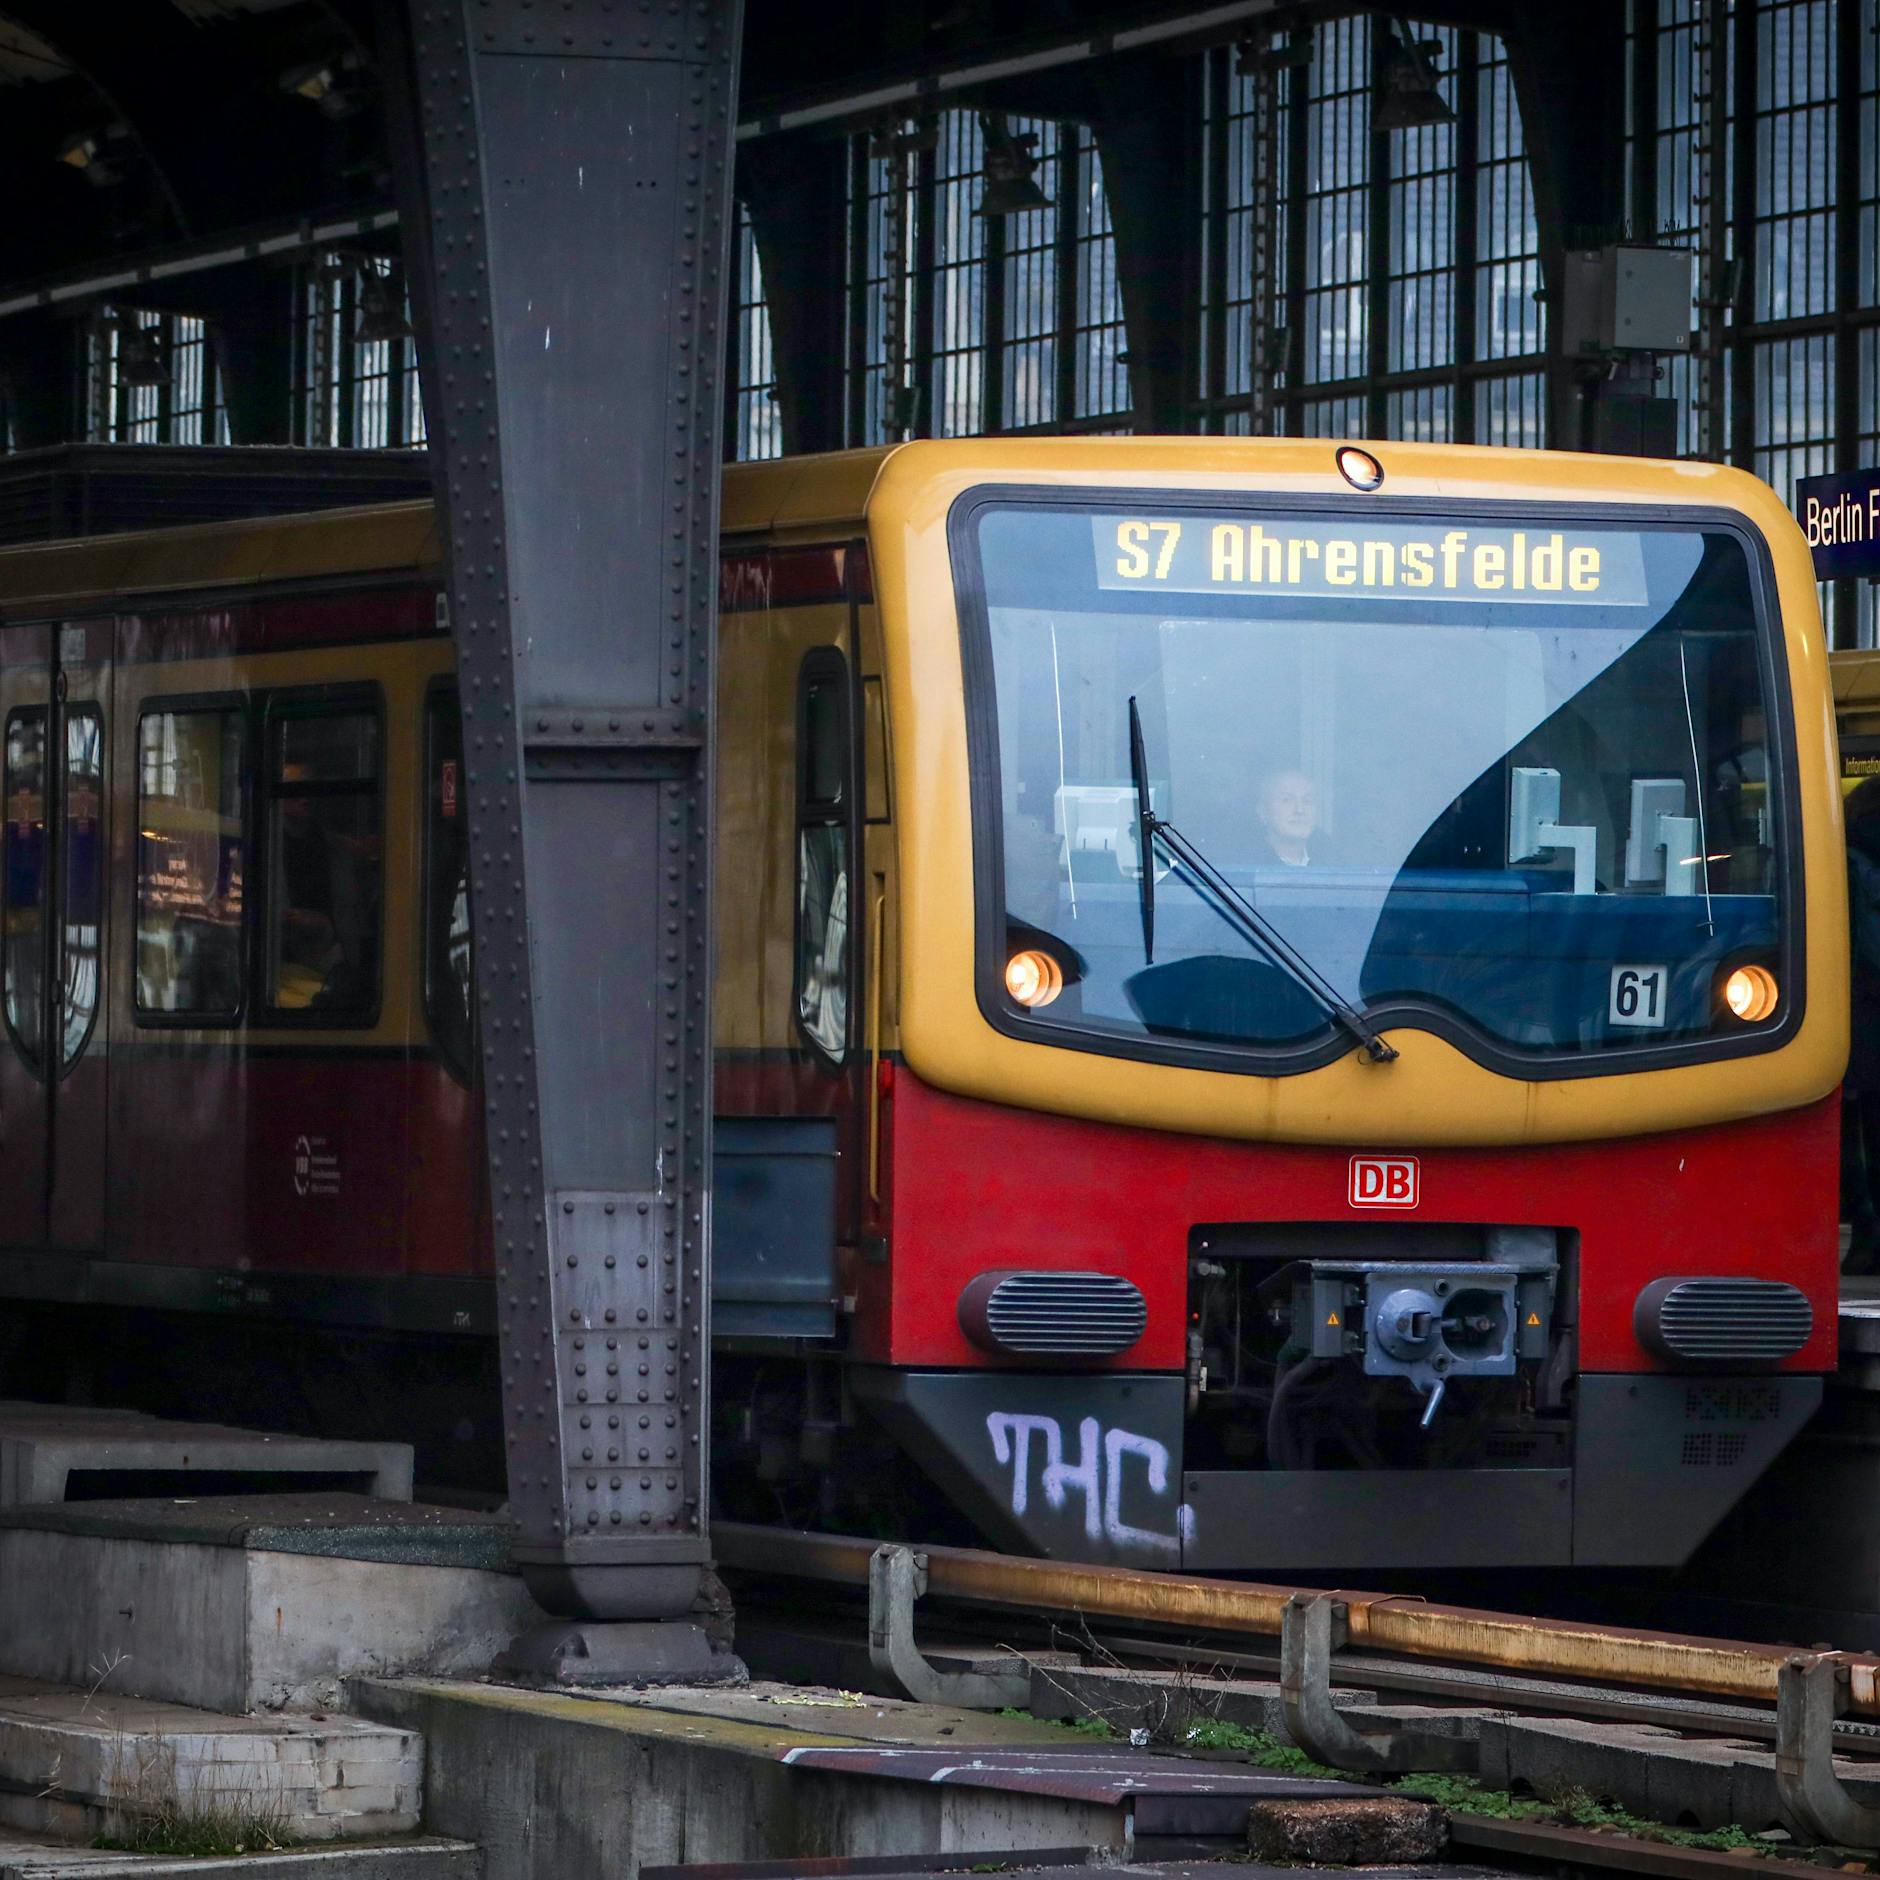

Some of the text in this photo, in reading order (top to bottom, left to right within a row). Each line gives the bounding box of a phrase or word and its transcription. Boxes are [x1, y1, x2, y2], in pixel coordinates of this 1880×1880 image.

[1807, 492, 1863, 548] Berlin
[1117, 521, 1600, 591] S7 Ahrensfelde
[1616, 970, 1659, 1018] 61
[1359, 1164, 1411, 1199] DB
